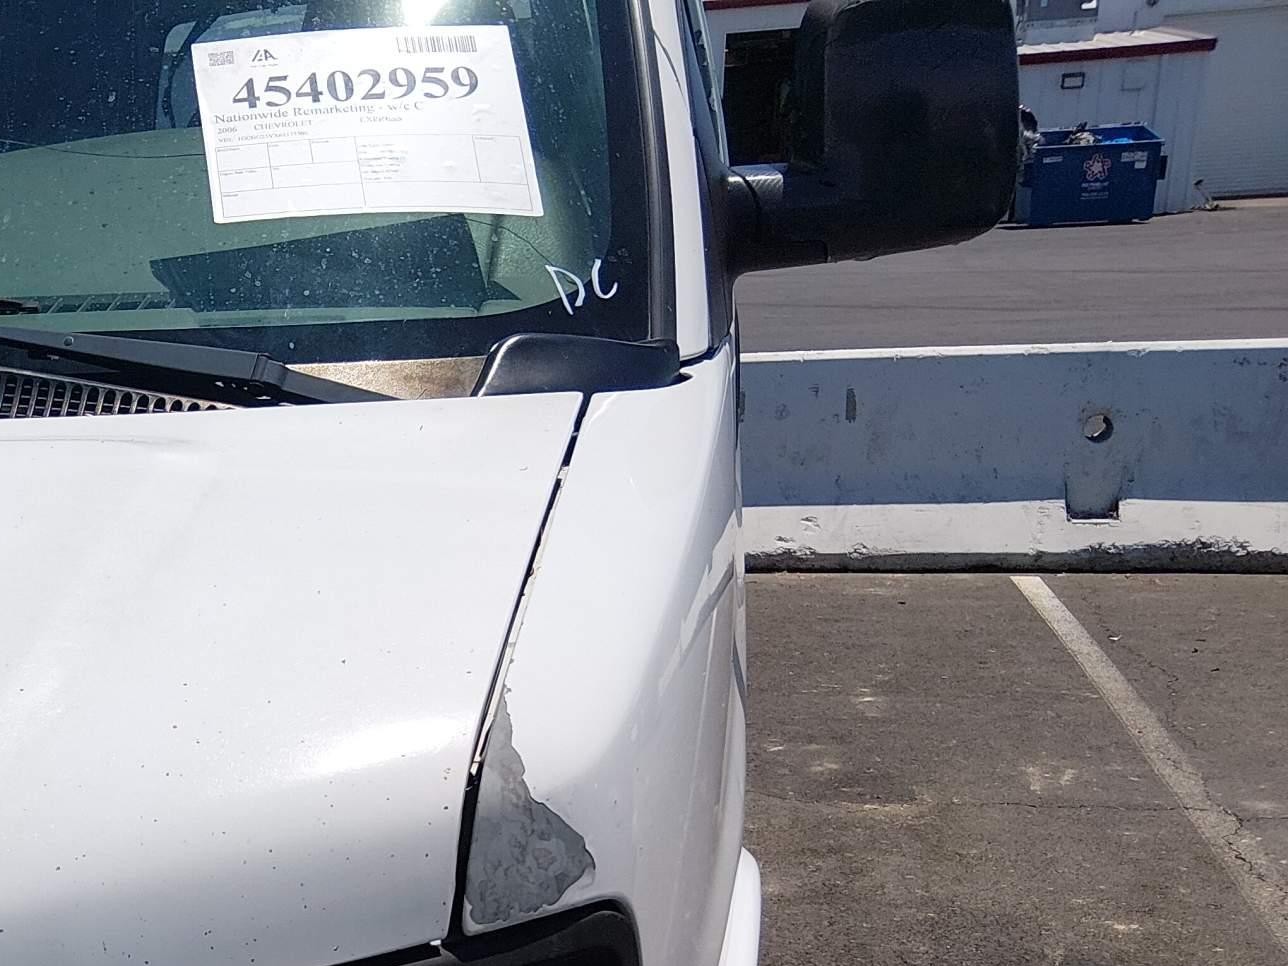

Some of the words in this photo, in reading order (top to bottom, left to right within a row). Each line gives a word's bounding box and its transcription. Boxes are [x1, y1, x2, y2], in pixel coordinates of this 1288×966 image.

[232, 66, 479, 109] 45402959
[214, 109, 289, 125] Nationwide
[293, 102, 376, 117] Remarketing
[253, 119, 312, 131] CHEVROLET
